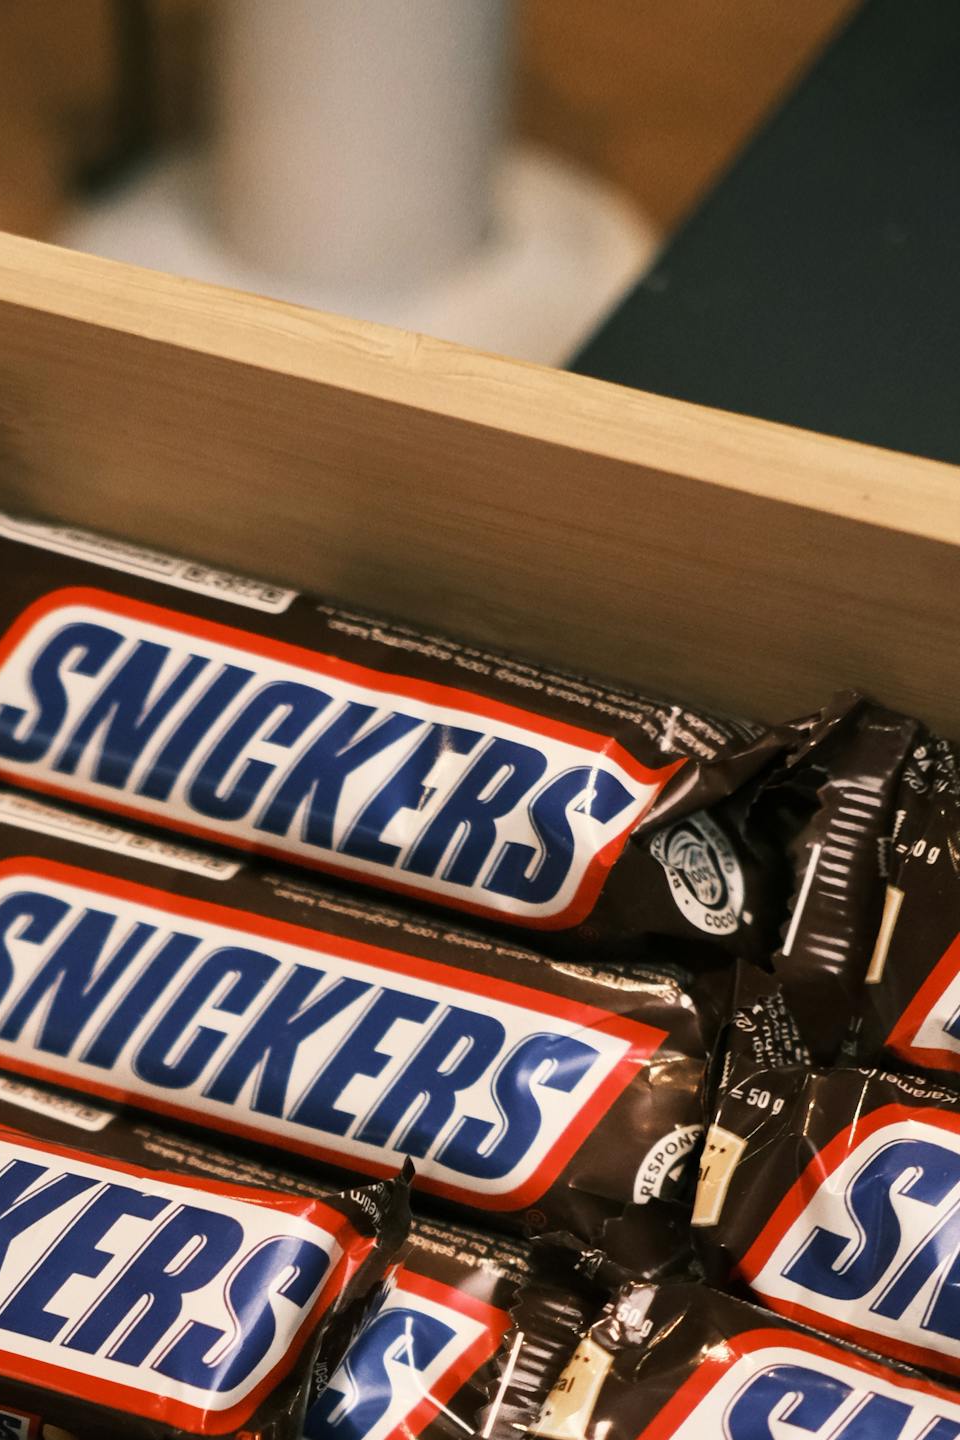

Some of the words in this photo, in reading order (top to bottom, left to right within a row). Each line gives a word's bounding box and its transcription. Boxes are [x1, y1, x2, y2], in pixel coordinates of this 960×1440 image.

[746, 1088, 772, 1108] 50
[771, 1097, 785, 1115] g
[878, 1071, 958, 1103] Karamel
